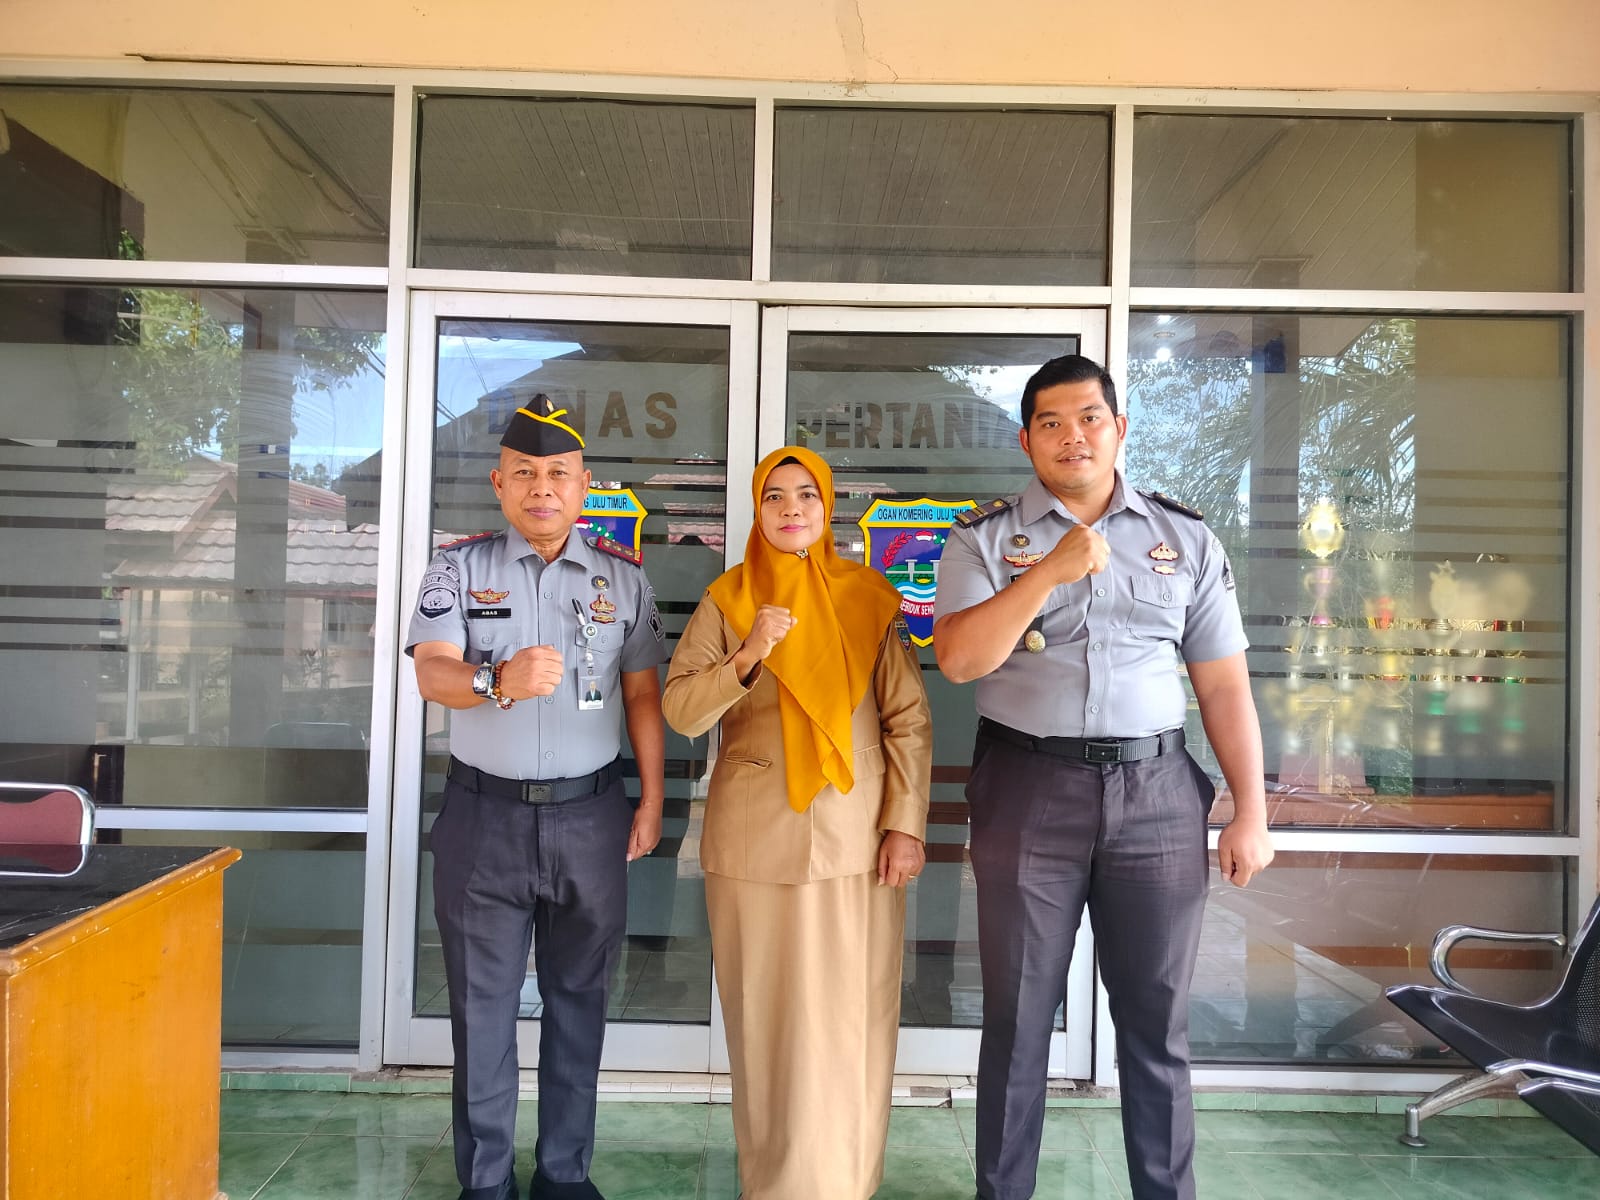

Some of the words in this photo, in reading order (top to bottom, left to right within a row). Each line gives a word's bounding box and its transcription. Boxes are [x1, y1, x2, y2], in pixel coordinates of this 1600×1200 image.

[488, 389, 678, 439] DNAS
[795, 402, 1020, 449] PERTANIA
[592, 496, 606, 508] ULU
[607, 497, 628, 509] TIMUR
[877, 508, 897, 520] OGAN
[898, 508, 933, 521] KOMERING
[936, 508, 950, 521] ULU
